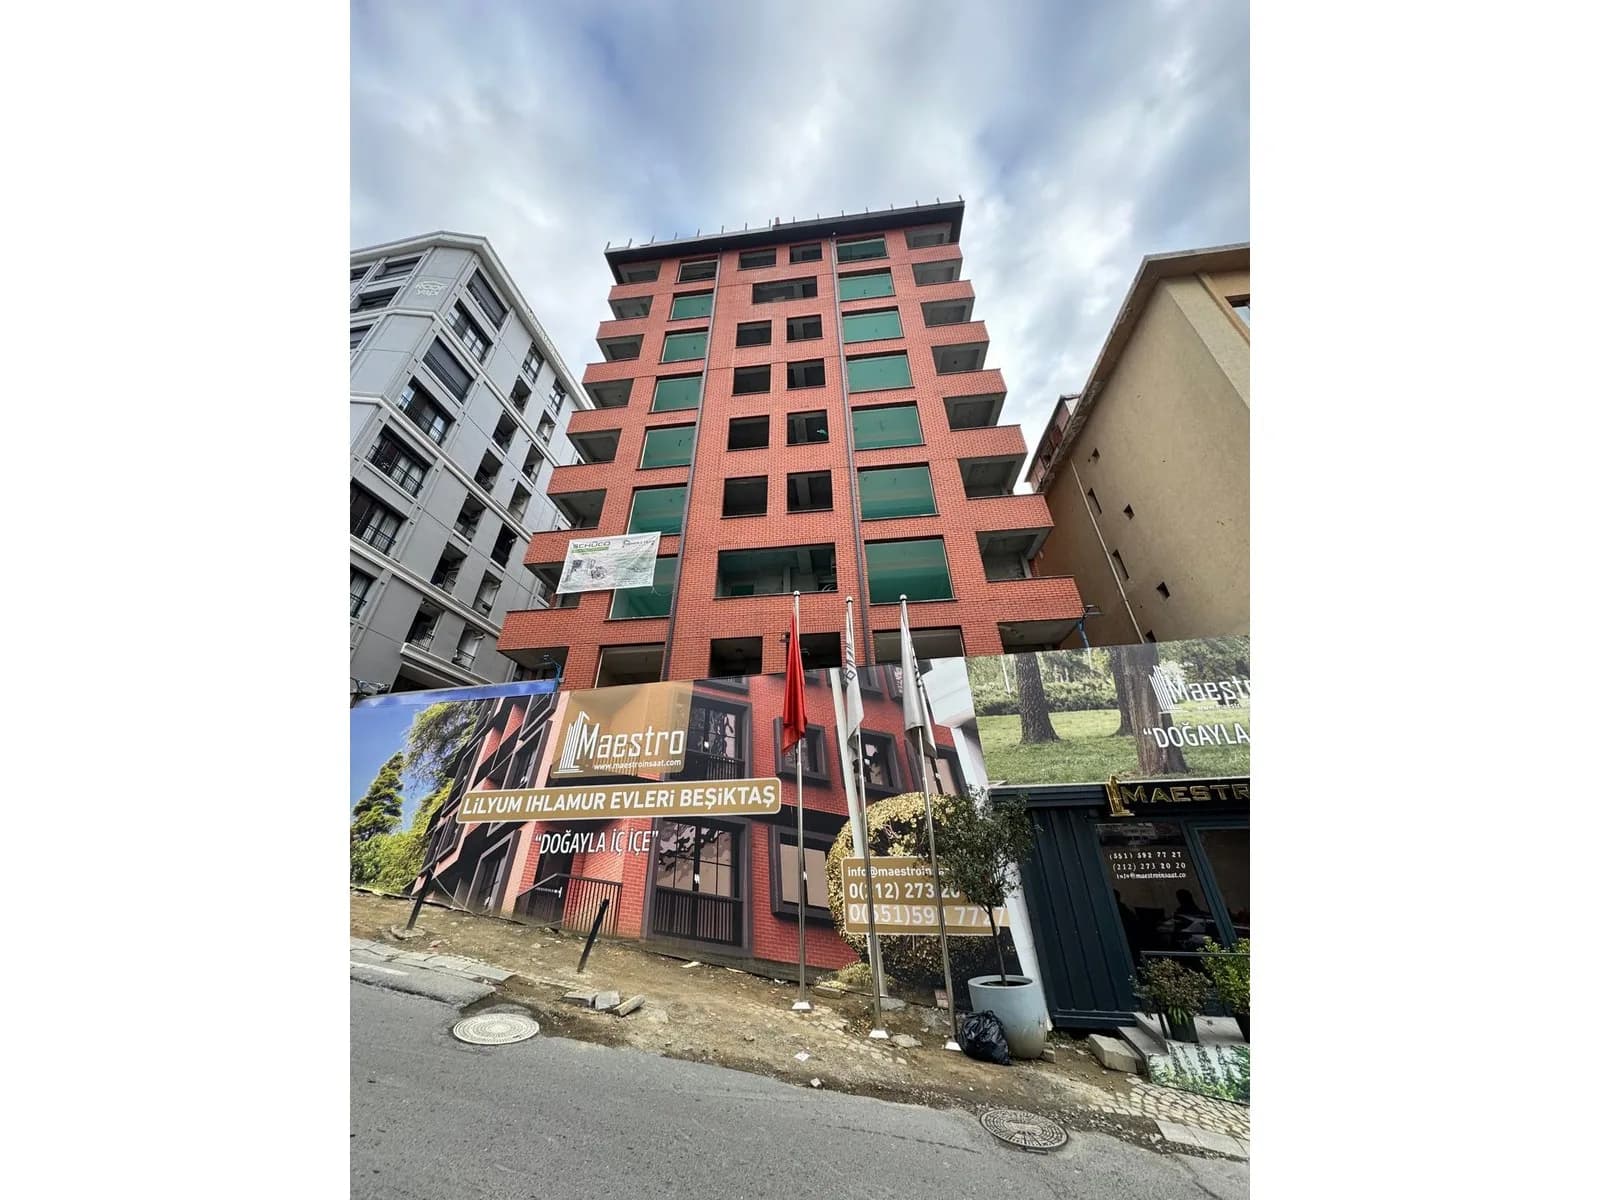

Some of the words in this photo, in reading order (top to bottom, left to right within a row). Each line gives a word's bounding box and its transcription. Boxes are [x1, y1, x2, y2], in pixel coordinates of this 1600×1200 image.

[576, 723, 685, 759] Maestro
[593, 759, 682, 770] www.maestroinsaat.com
[525, 792, 606, 813] IHLAMUR
[1112, 863, 1136, 871] (212)
[1140, 862, 1156, 870] 273
[904, 882, 935, 899] 273
